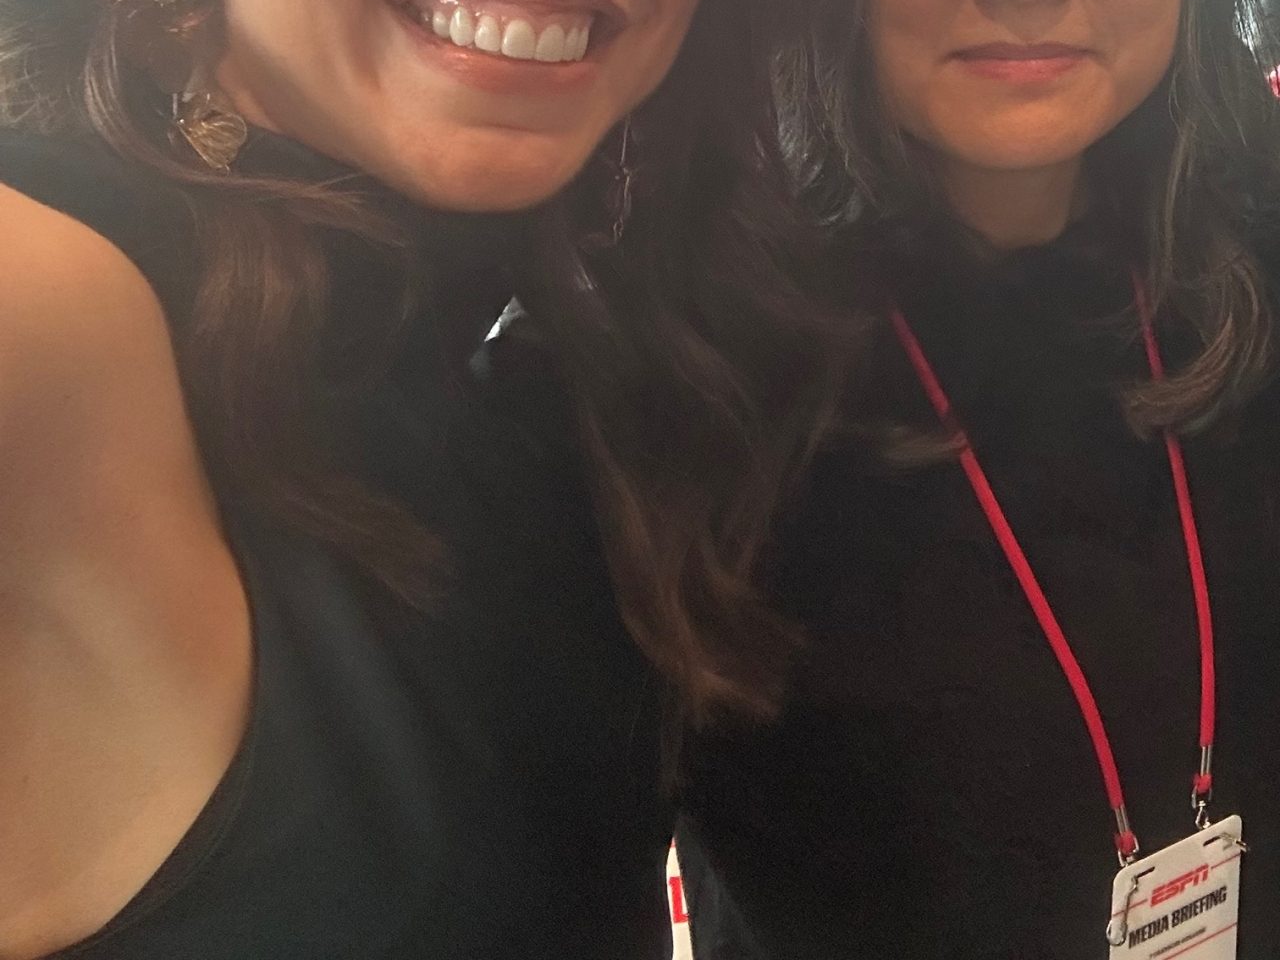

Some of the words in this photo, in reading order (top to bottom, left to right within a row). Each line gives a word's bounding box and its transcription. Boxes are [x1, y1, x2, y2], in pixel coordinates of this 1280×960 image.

[1150, 863, 1210, 907] ESPN
[1128, 918, 1170, 949] MEDIA
[1171, 885, 1227, 929] BRIEFING
